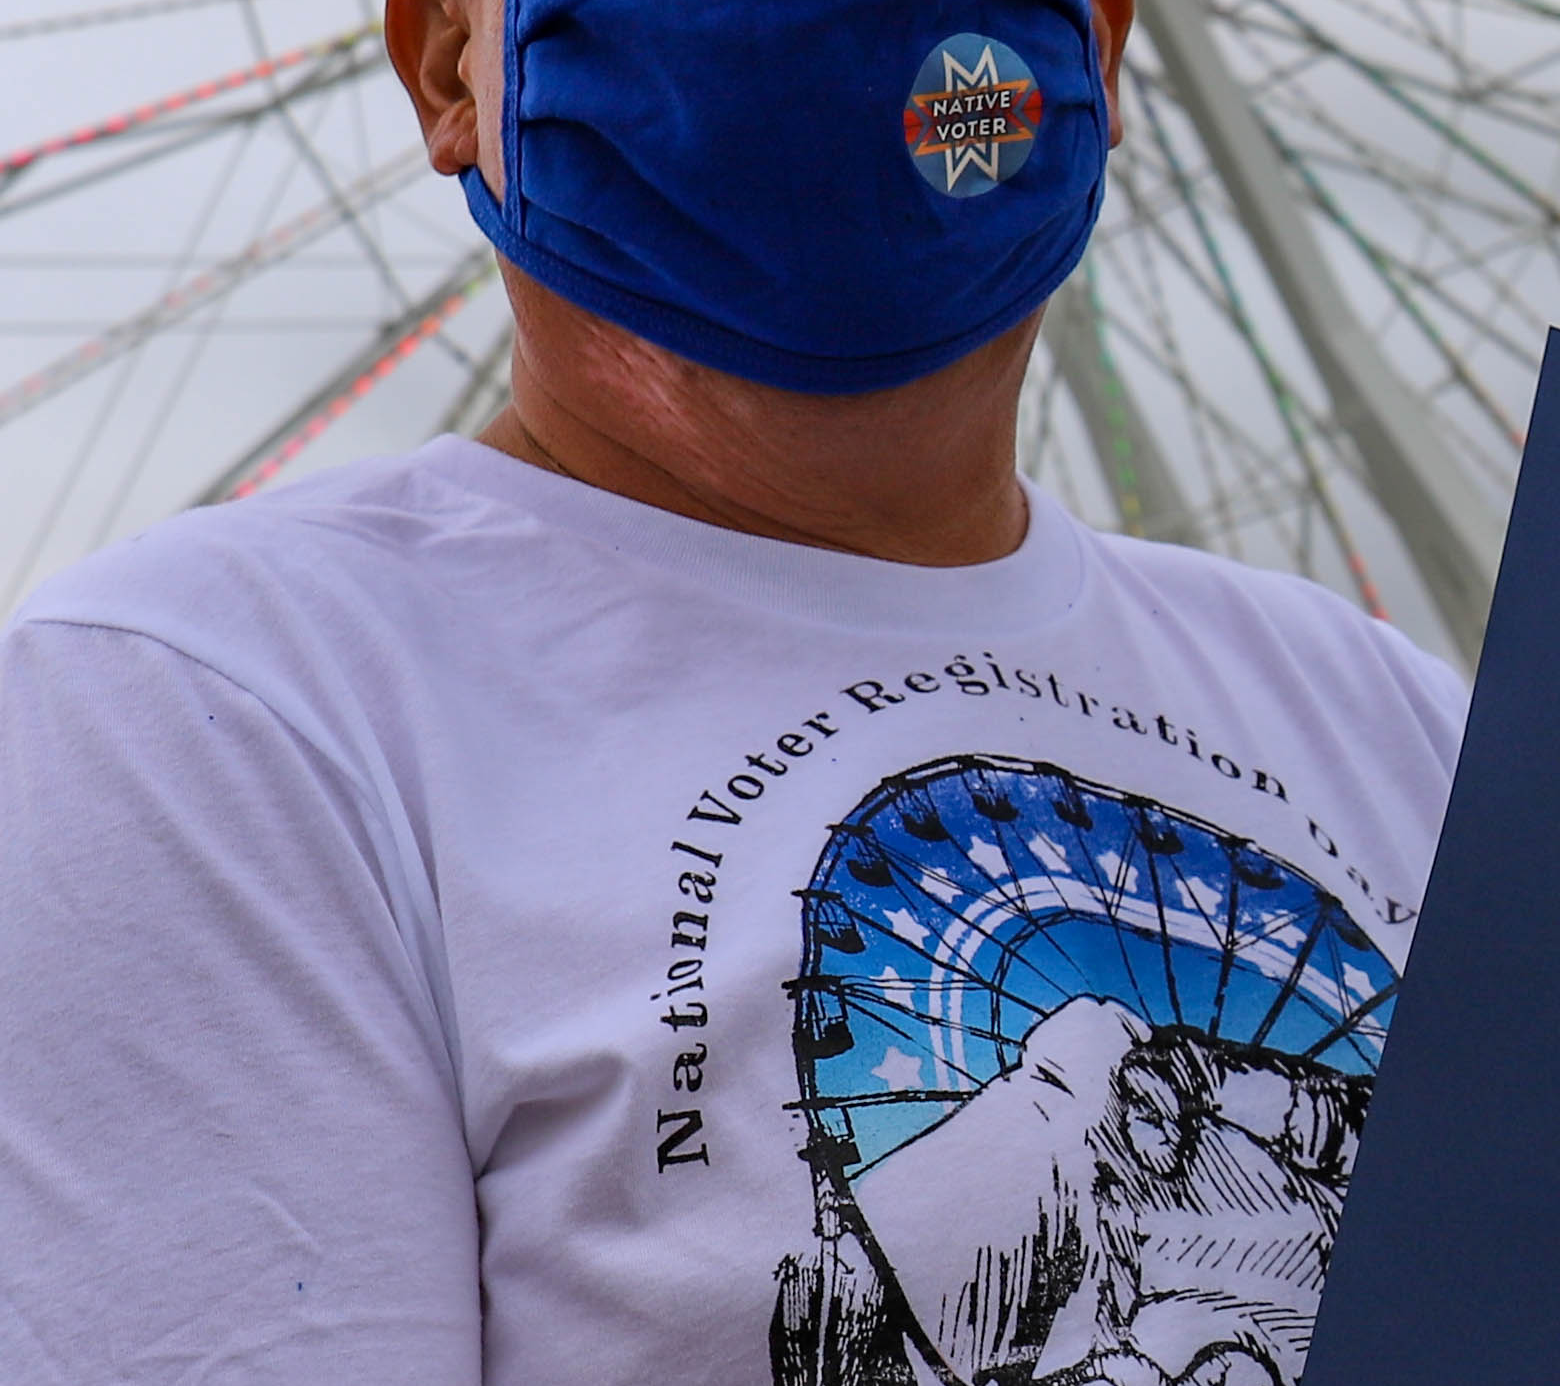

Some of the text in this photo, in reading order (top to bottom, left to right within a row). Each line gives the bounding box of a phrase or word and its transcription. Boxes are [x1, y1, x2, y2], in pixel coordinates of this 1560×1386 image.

[933, 90, 1011, 118] NATIVE
[936, 117, 1008, 142] VOTER
[649, 840, 723, 1174] National
[687, 710, 840, 826] Voter
[839, 650, 1290, 804] Registration
